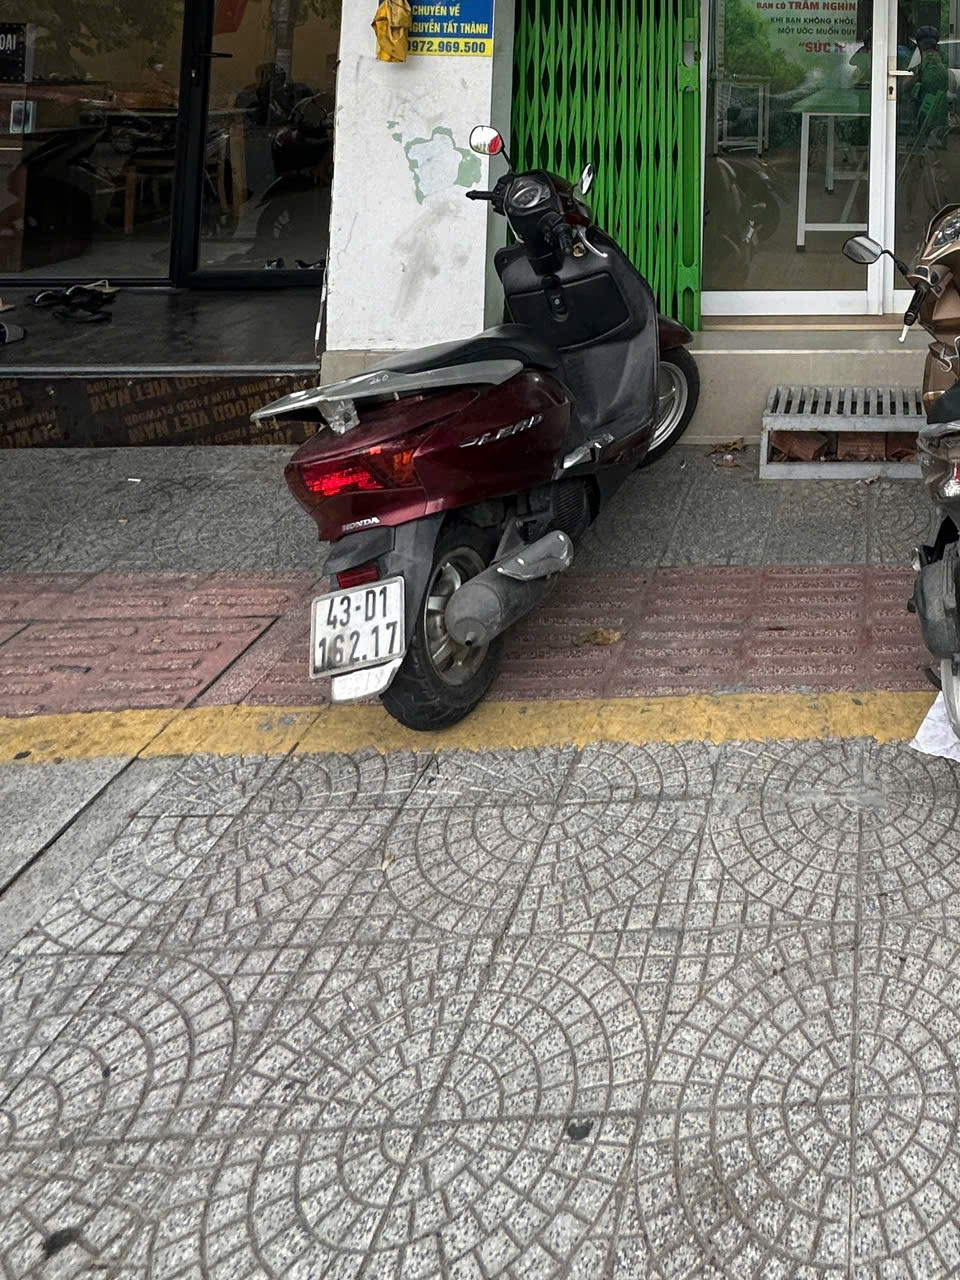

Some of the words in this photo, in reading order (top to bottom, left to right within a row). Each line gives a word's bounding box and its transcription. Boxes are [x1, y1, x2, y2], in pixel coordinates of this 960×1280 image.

[788, 0, 820, 11] TRĂM
[822, 1, 857, 11] NGHÌN
[442, 19, 459, 34] TẤT
[460, 21, 489, 34] THÀNH
[803, 16, 832, 25] KHÔNG
[341, 516, 381, 532] HONDA
[326, 586, 388, 630] 43-D1
[318, 621, 398, 669] 162.17
